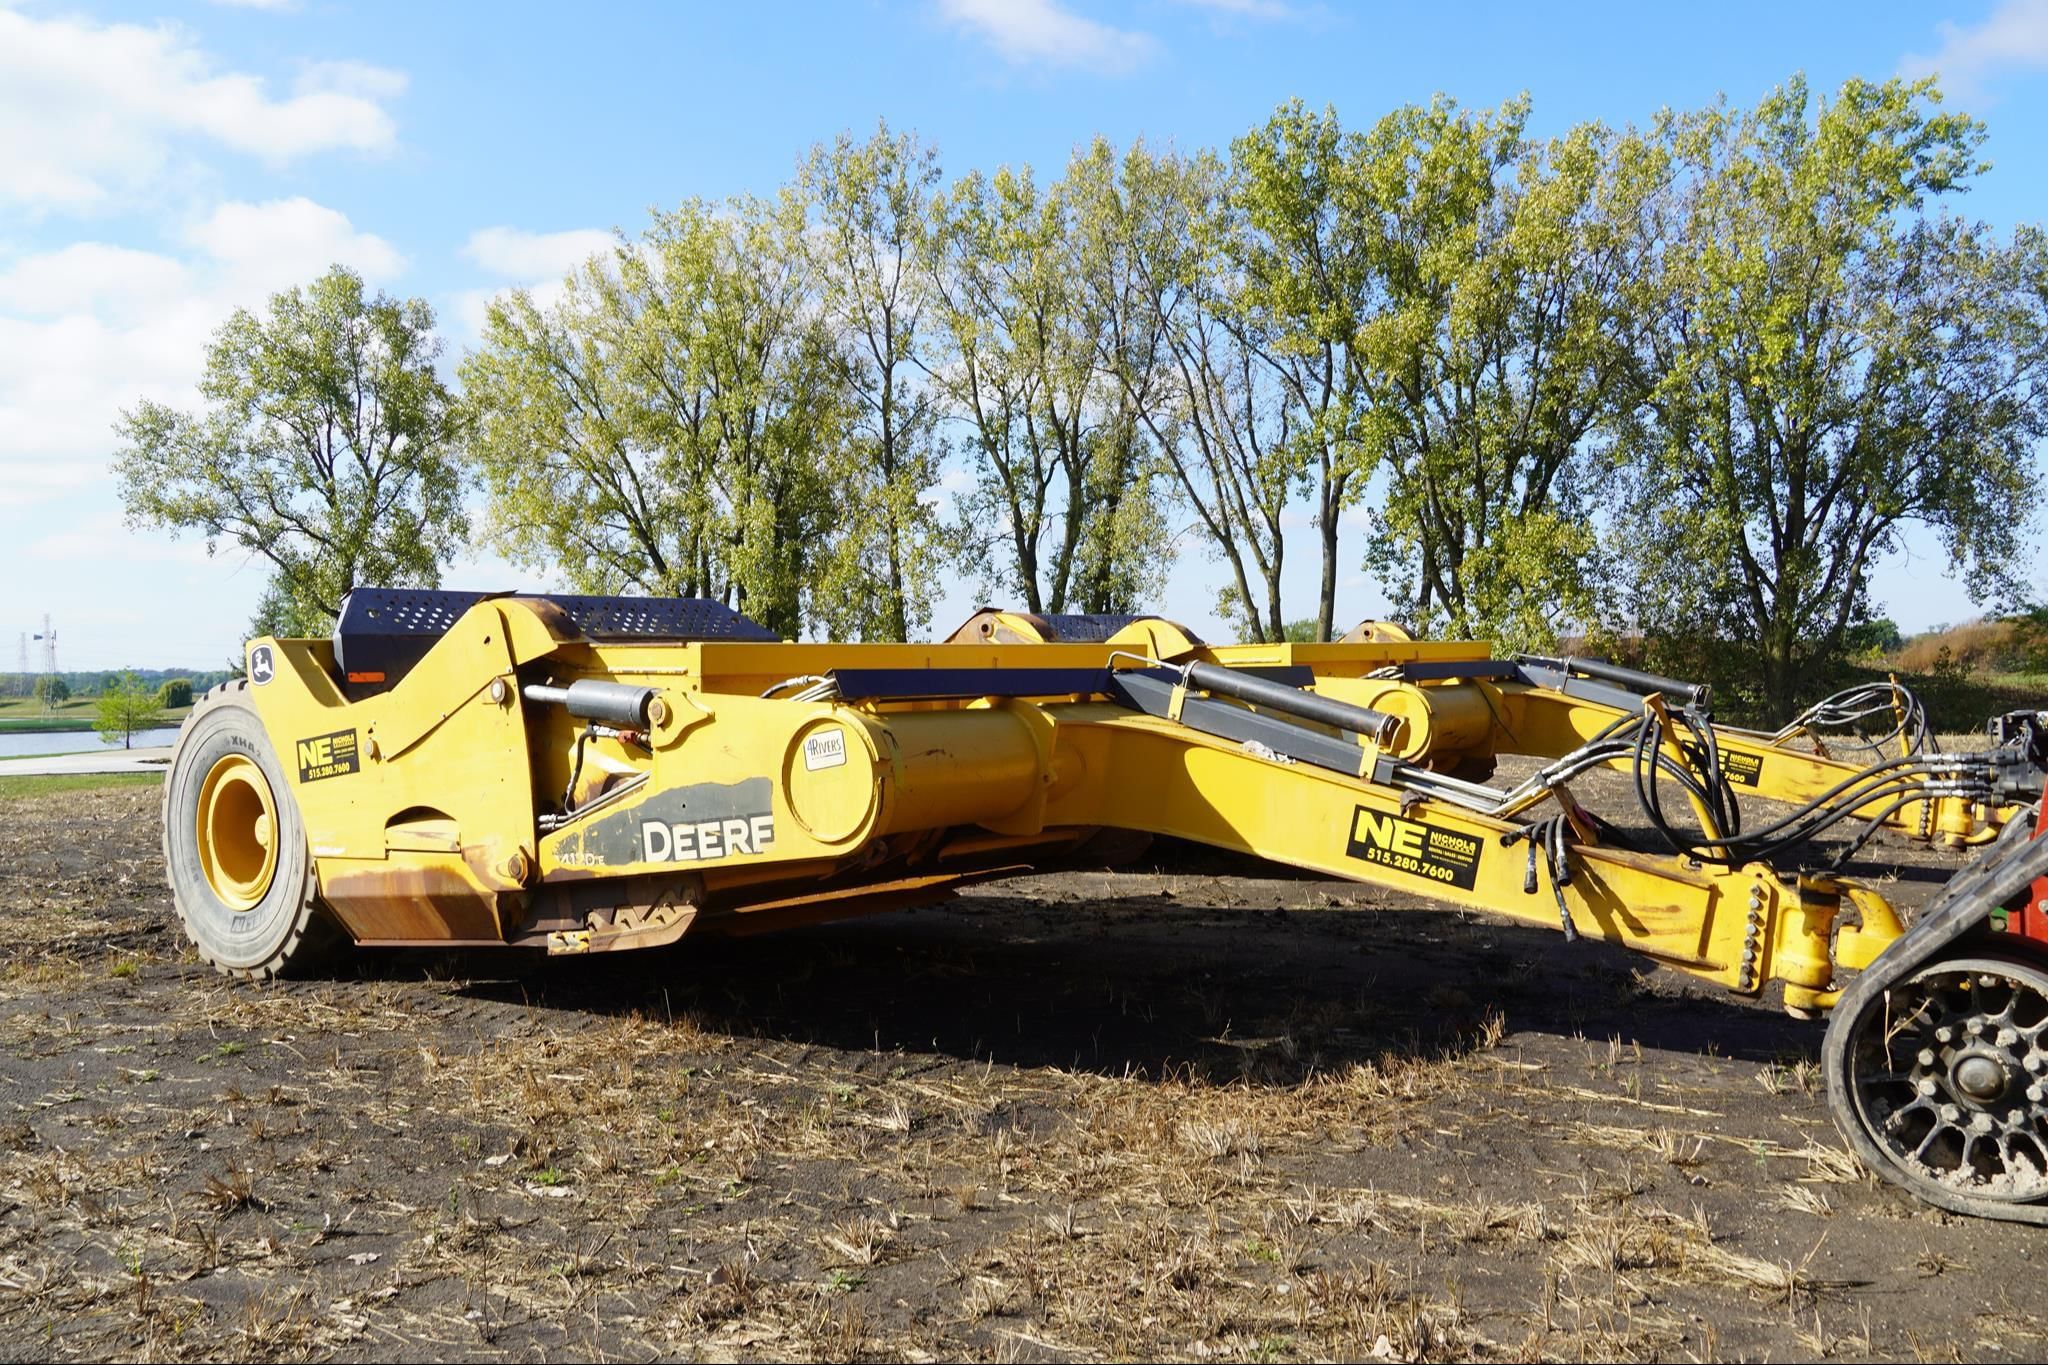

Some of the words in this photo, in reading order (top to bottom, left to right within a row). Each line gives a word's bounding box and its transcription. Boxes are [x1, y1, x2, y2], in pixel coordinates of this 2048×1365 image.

[298, 737, 334, 770] NE
[308, 761, 351, 780] 515.280.7600
[1354, 809, 1428, 859] NE
[1430, 831, 1477, 851] NICHOLS
[1367, 848, 1454, 882] 515.280.7600
